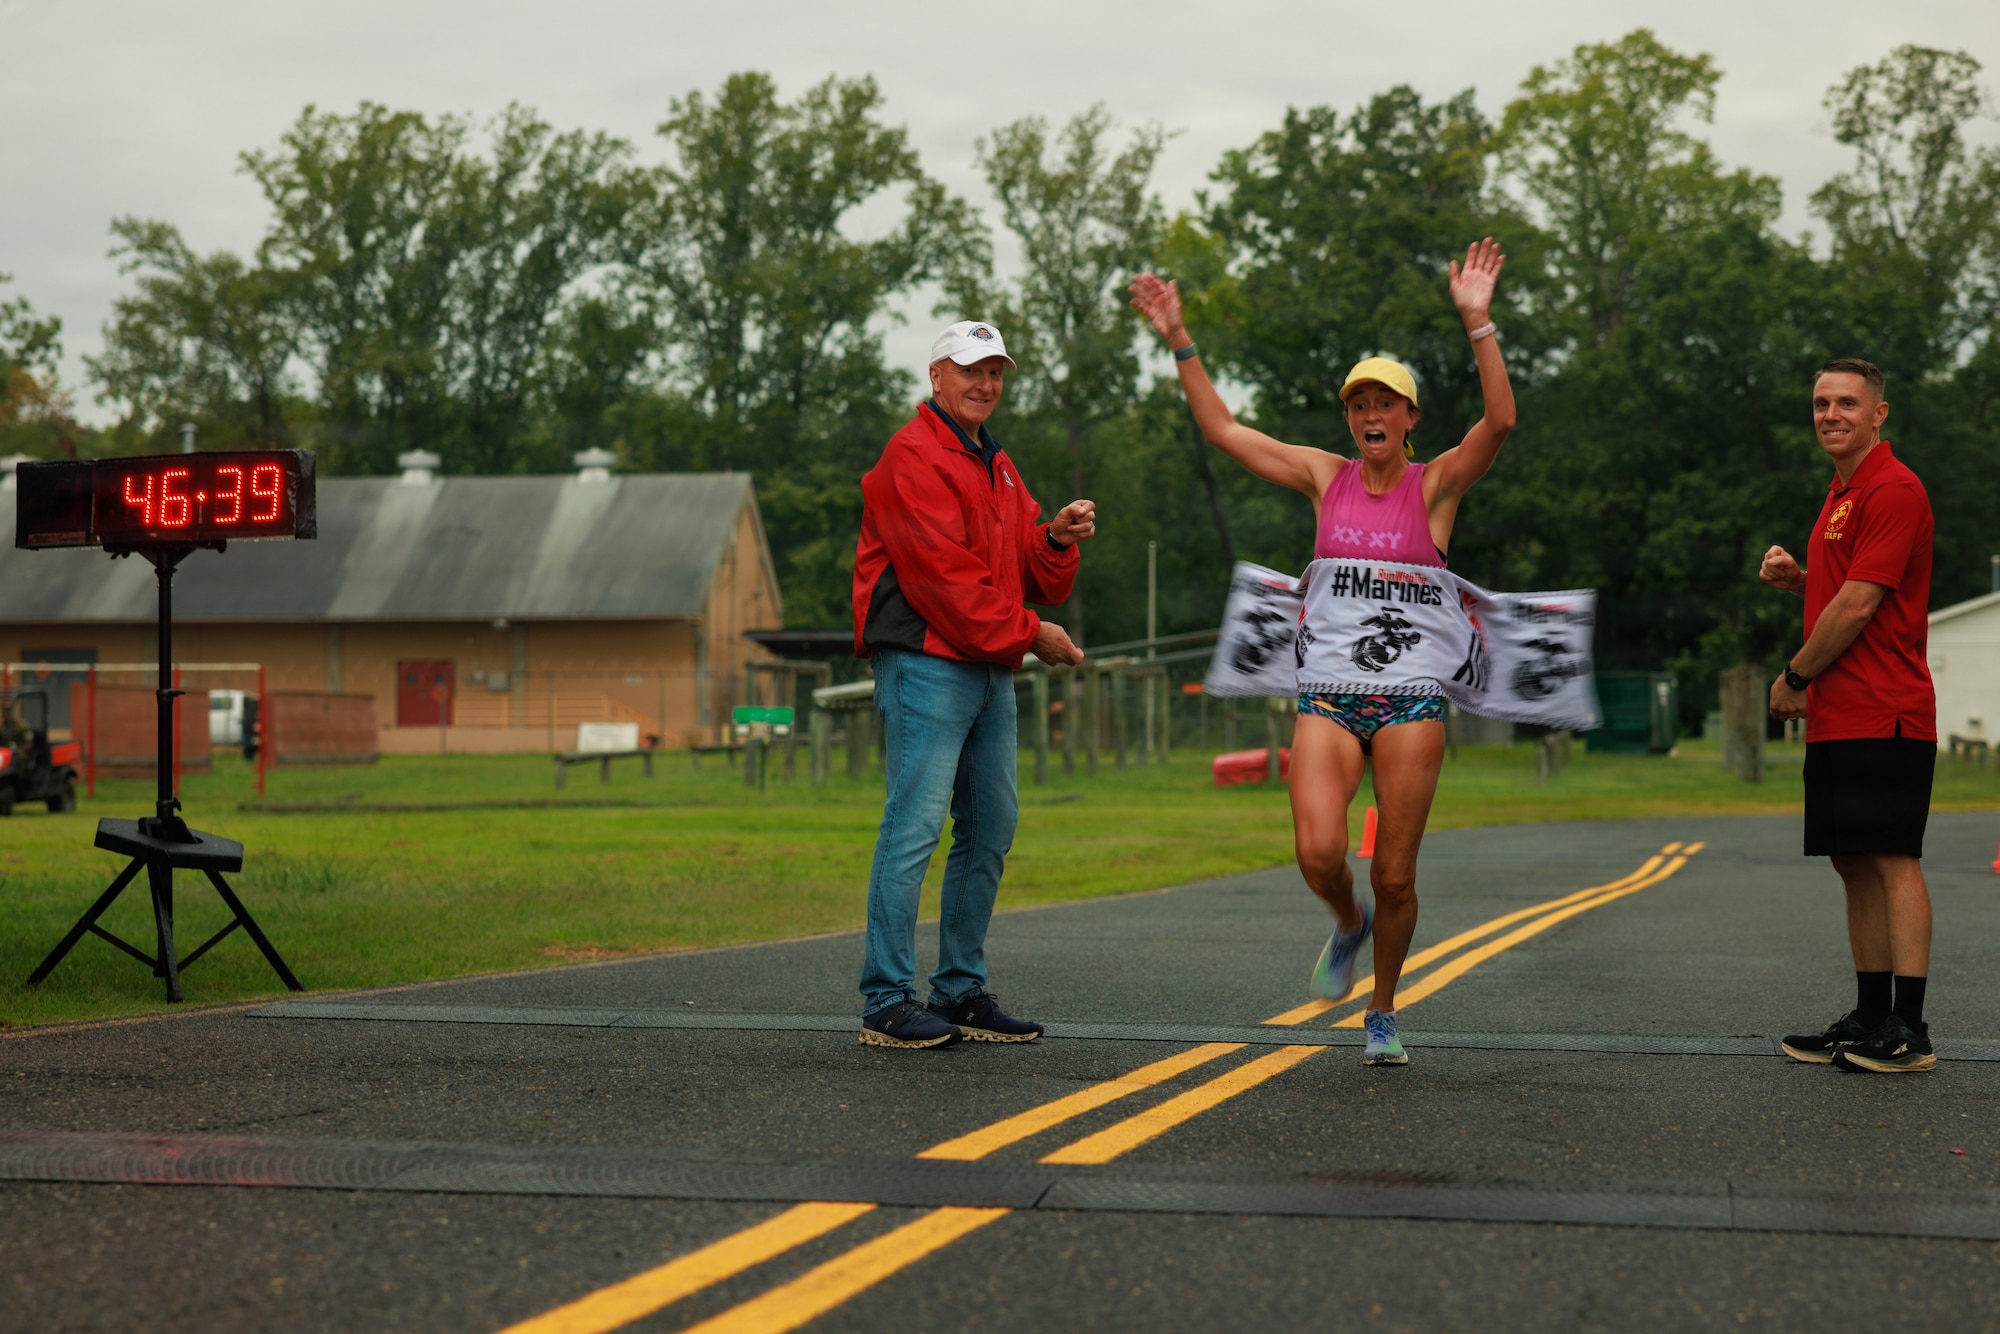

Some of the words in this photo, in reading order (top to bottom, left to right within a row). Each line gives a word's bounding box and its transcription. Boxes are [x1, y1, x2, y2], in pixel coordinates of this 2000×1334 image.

[1330, 524, 1402, 549] XX-XY
[1824, 532, 1843, 540] STAFF
[1331, 566, 1442, 605] #Marines
